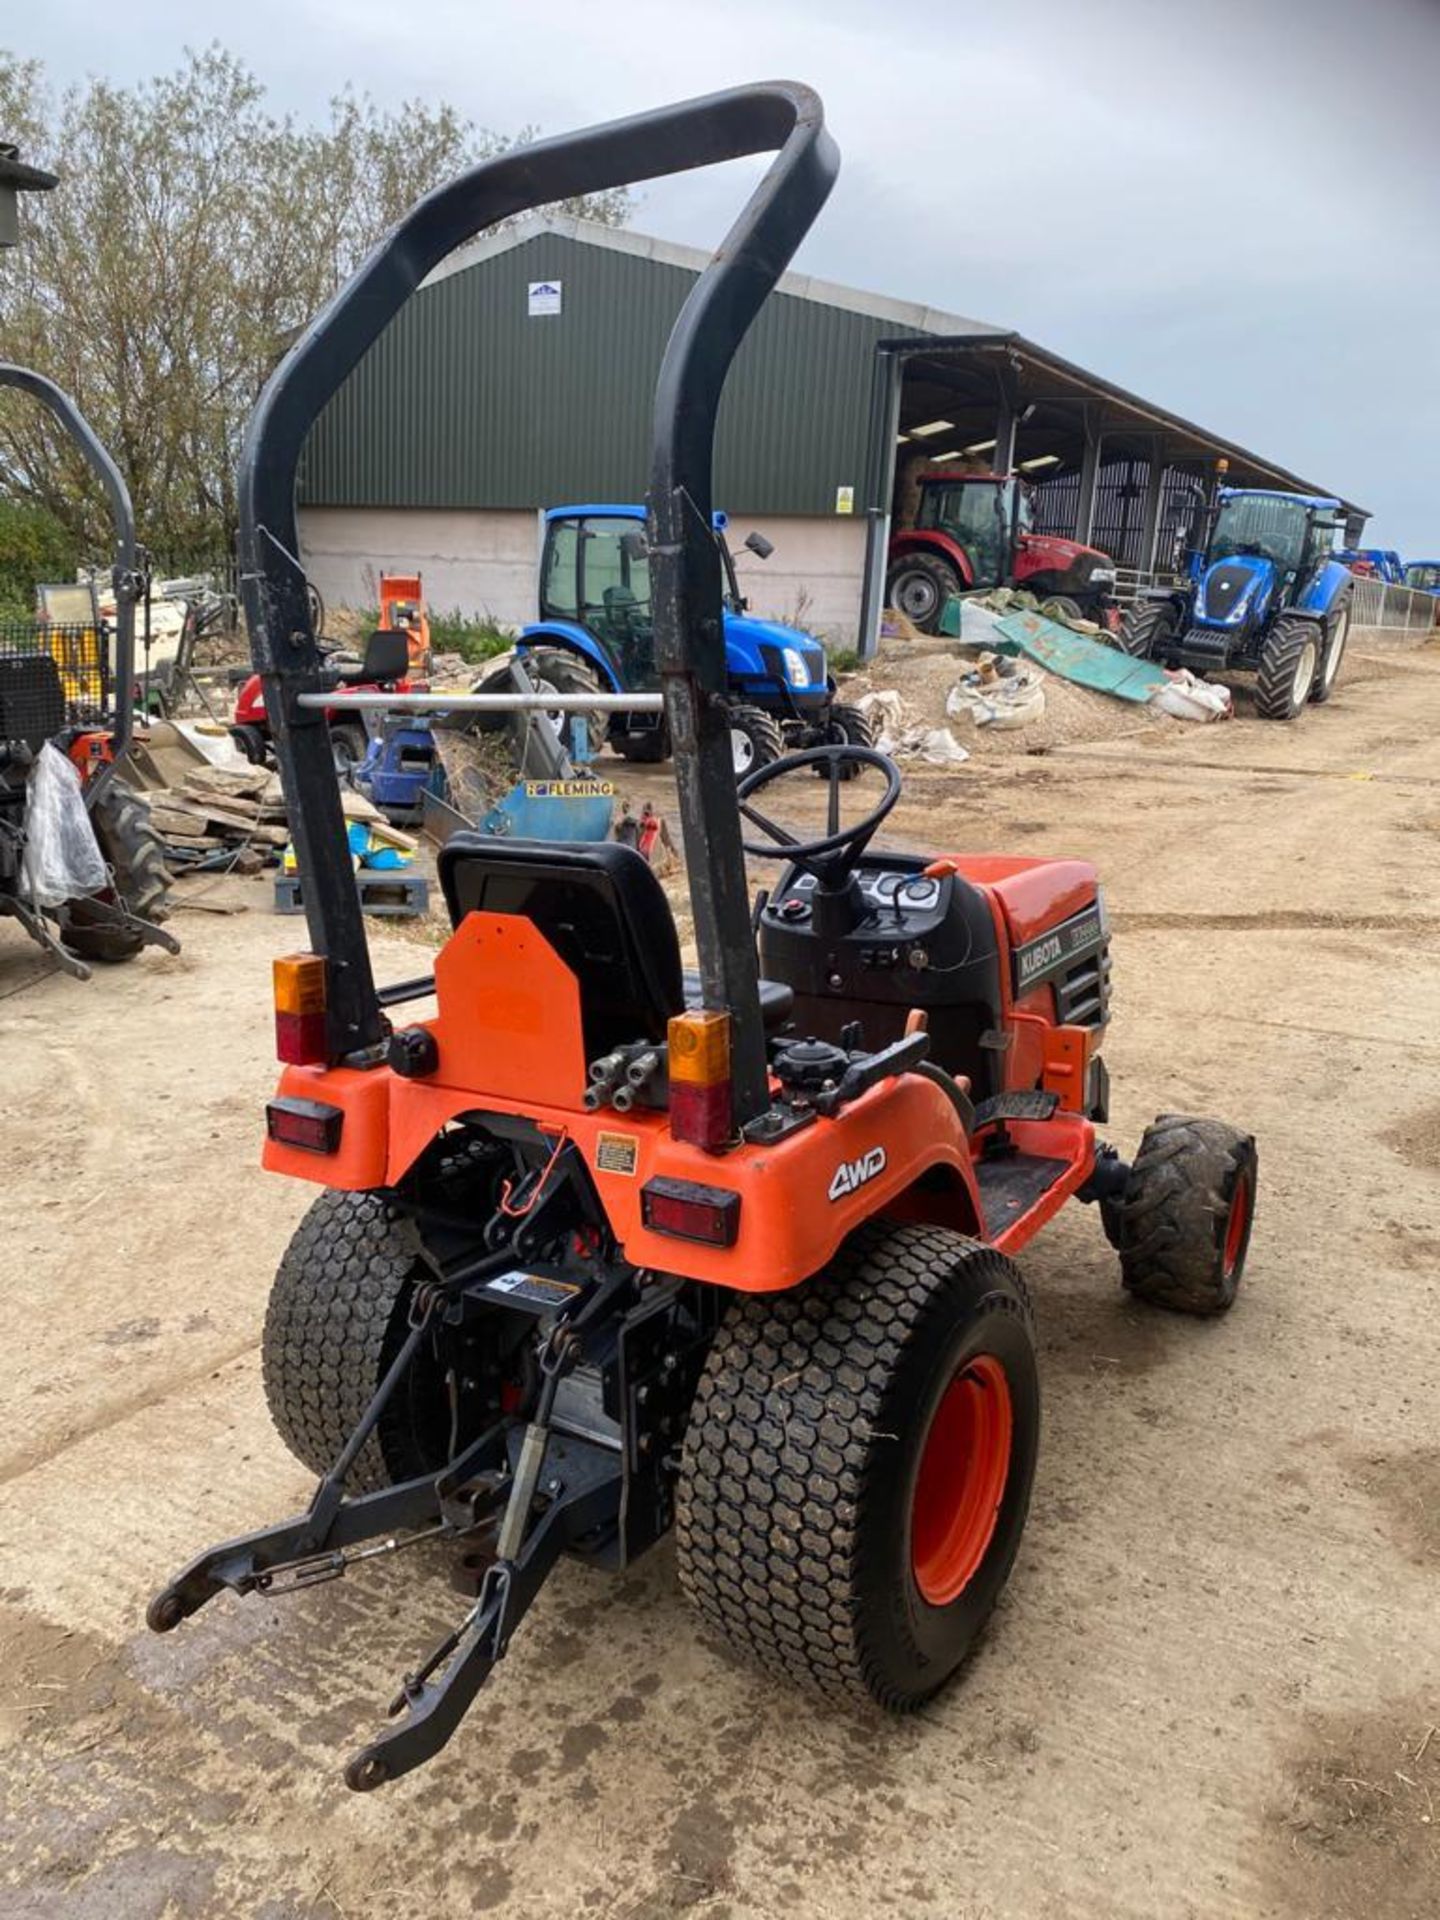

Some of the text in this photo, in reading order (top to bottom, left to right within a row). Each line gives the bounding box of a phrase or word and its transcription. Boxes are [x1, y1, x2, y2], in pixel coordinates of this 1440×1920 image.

[549, 783, 611, 795] FLEMING
[1021, 935, 1062, 976] KUBOTA
[828, 1146, 887, 1201] 4WD
